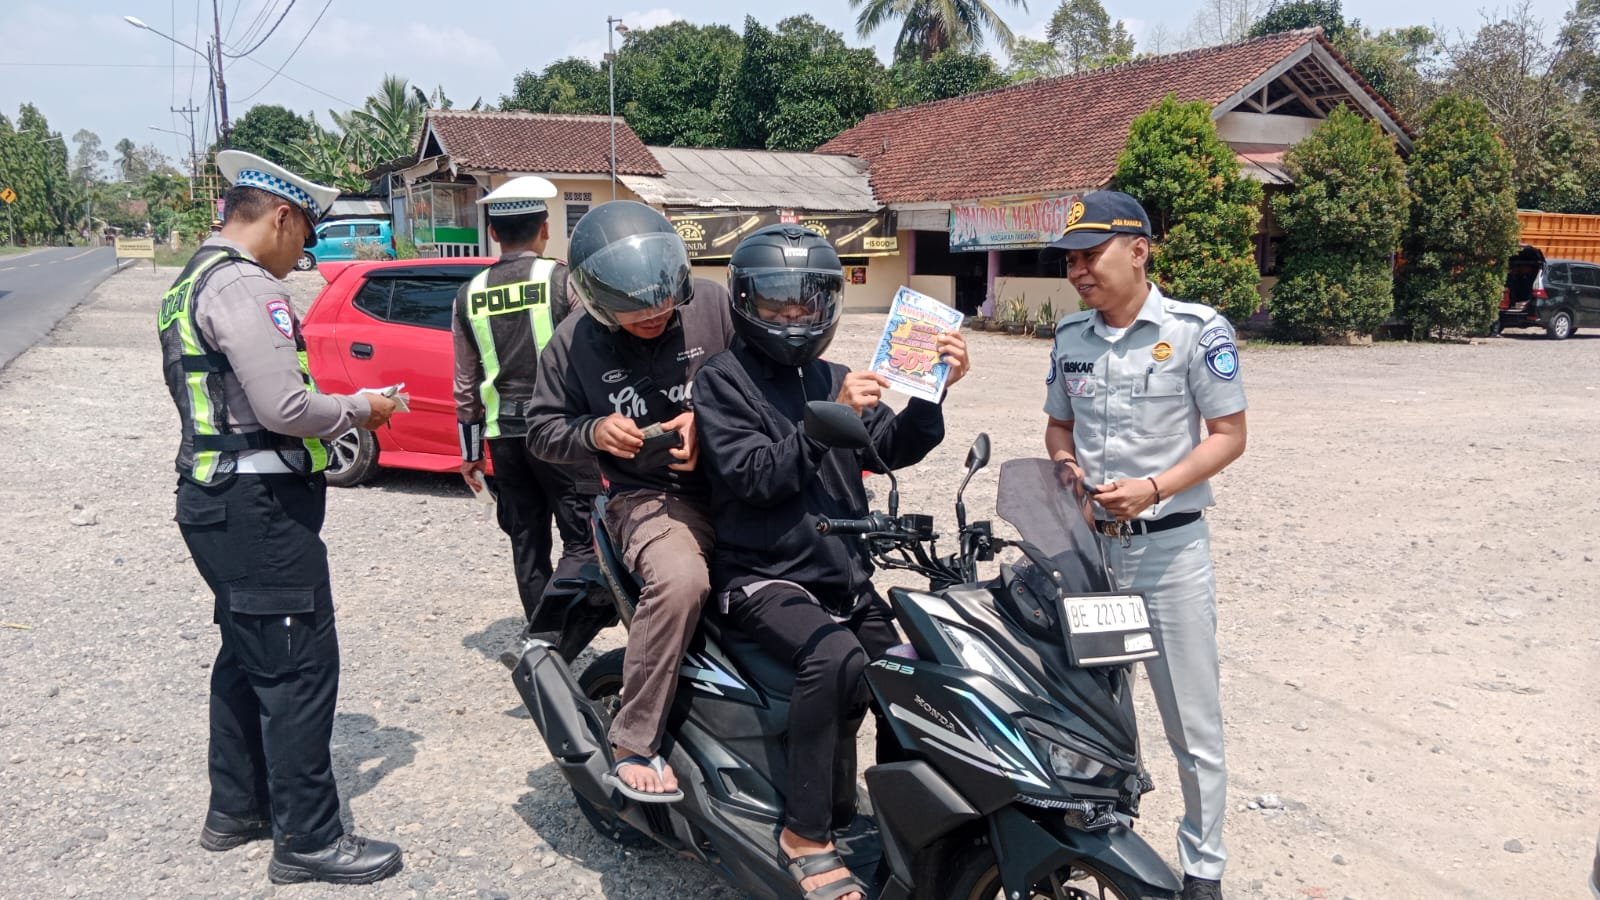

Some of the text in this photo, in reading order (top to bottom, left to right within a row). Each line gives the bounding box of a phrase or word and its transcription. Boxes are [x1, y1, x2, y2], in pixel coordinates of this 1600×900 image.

[471, 282, 547, 316] POLISI
[1070, 604, 1089, 628] BE
[1093, 602, 1126, 626] 2213
[870, 659, 916, 676] ABS
[913, 693, 958, 735] HONDA
